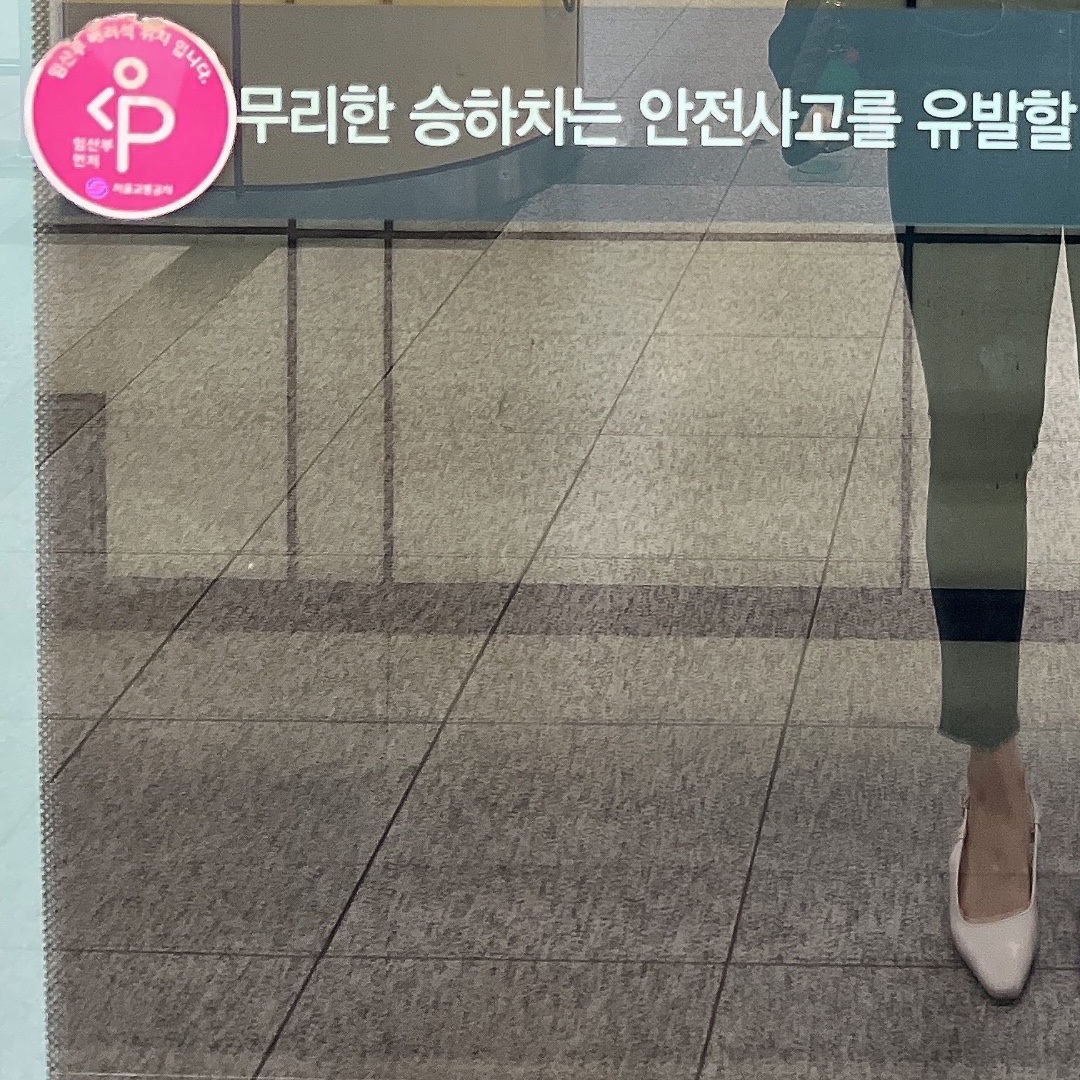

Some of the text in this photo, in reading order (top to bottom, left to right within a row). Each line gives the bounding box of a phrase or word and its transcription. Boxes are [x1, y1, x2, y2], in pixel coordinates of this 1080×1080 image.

[237, 84, 395, 146] 무리한
[409, 85, 623, 147] 승하차는
[638, 86, 903, 150] 안전사고를
[916, 88, 1079, 151] 유발할
